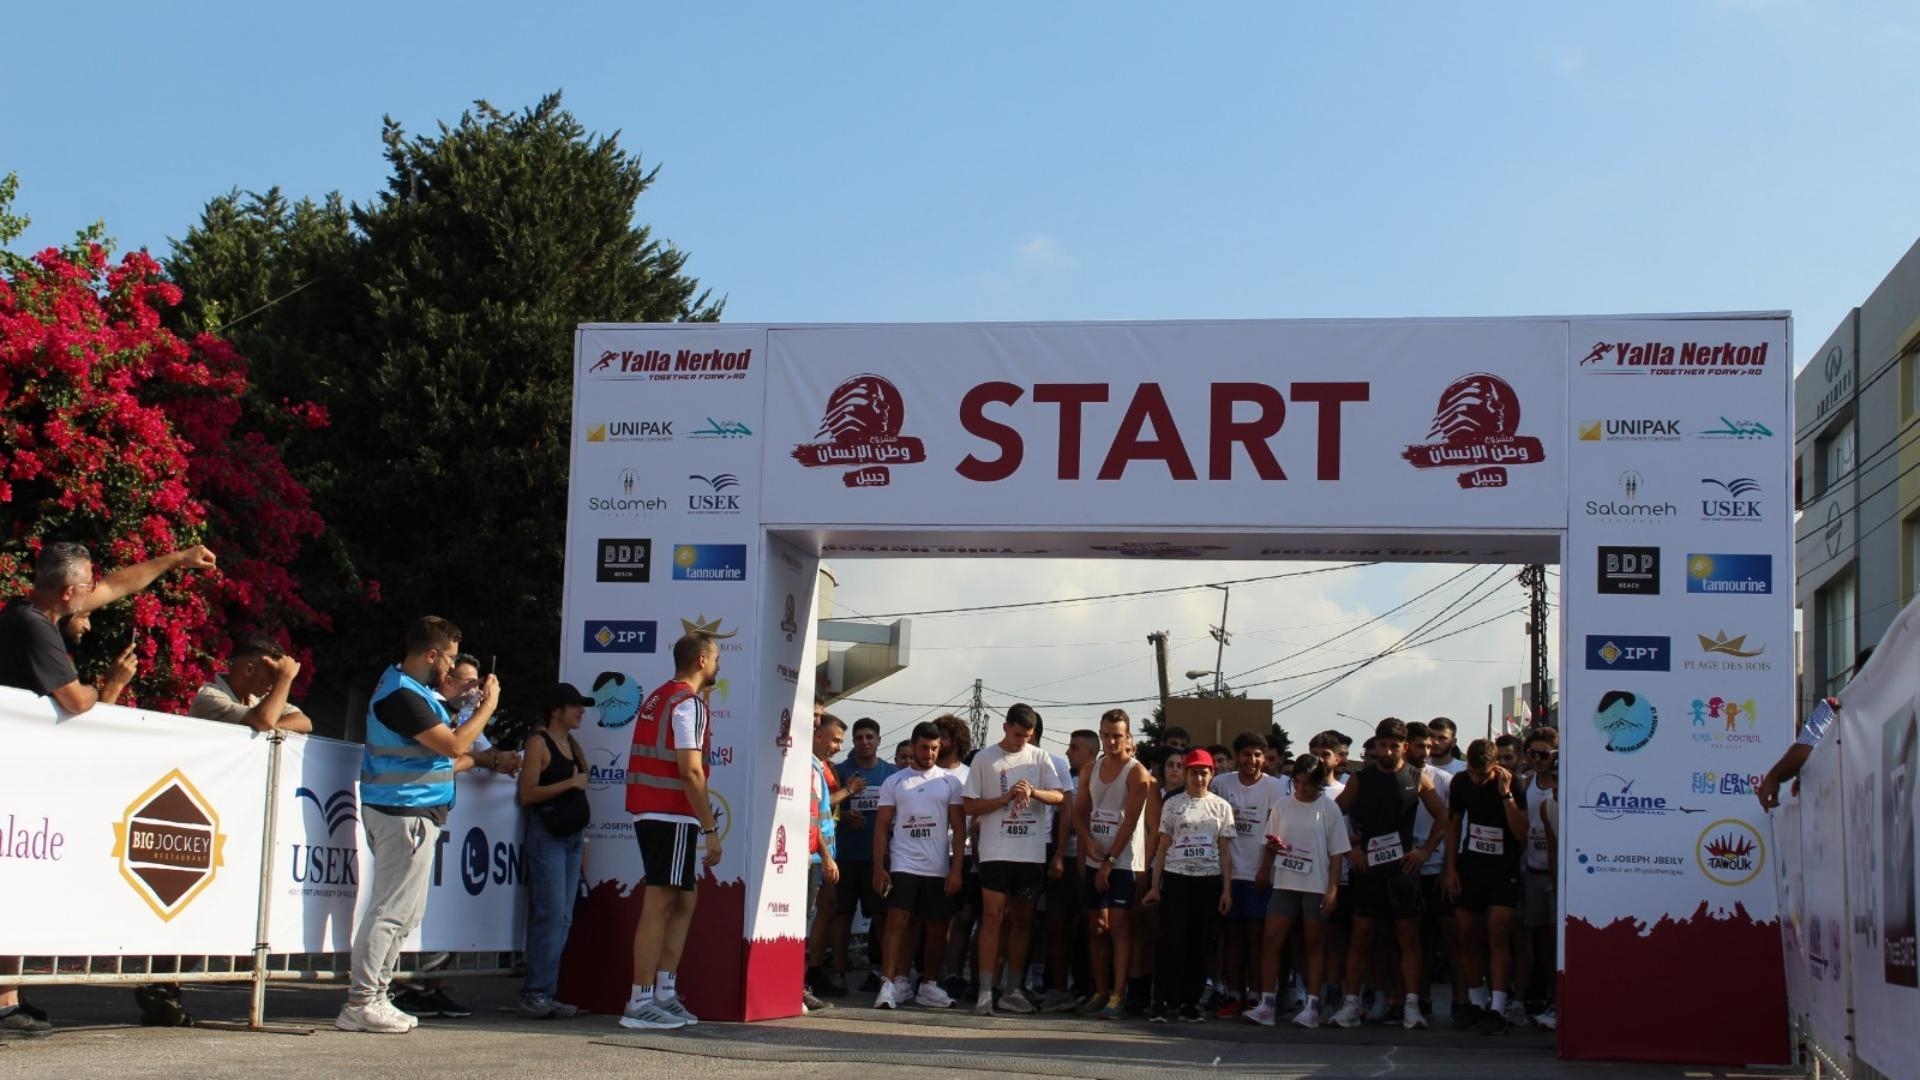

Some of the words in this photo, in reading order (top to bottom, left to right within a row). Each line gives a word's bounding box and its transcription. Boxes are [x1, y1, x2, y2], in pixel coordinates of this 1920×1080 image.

[621, 350, 671, 372] Yalla
[674, 349, 752, 371] Nerkod
[1616, 342, 1674, 366] Yalla
[1680, 342, 1768, 366] Nerkod
[1650, 368, 1705, 376] TOGETHER
[610, 422, 672, 436] UNIPAK
[957, 381, 1369, 482] START
[1606, 420, 1680, 435] UNIPAK
[816, 445, 872, 462] الإنسان
[875, 445, 910, 461] وطن
[1429, 445, 1488, 464] الإنسان
[1491, 445, 1528, 461] وطن
[856, 471, 884, 485] جبيل
[1472, 471, 1503, 486] جبيل
[588, 497, 667, 511] Salameh
[689, 496, 740, 510] USEK
[1586, 501, 1676, 516] Salameh
[1702, 501, 1762, 516] USEK
[605, 546, 645, 563] BDP
[1607, 554, 1653, 573] BDP
[686, 566, 741, 579] tannourine
[1703, 578, 1766, 592] tannourine
[617, 631, 646, 643] IPT
[1624, 648, 1658, 660] IPT
[1684, 660, 1718, 670] PLAGE
[1722, 661, 1743, 670] DES
[1746, 662, 1771, 671] ROIS
[590, 764, 628, 779] Aria
[1596, 792, 1666, 809] Ariane
[600, 823, 632, 831] JOSEPH
[132, 830, 154, 850] BIG
[155, 834, 210, 852] JOCKEY
[154, 852, 206, 862] RESTAURANT
[1184, 848, 1205, 857] 4519
[1374, 848, 1397, 862] 4034
[1596, 854, 1610, 863] Dr.
[1612, 855, 1650, 864] JOSEPH
[1653, 856, 1684, 866] JBEILY
[292, 844, 358, 885] USEK
[493, 842, 528, 886] SN
[1282, 858, 1304, 870] 4523
